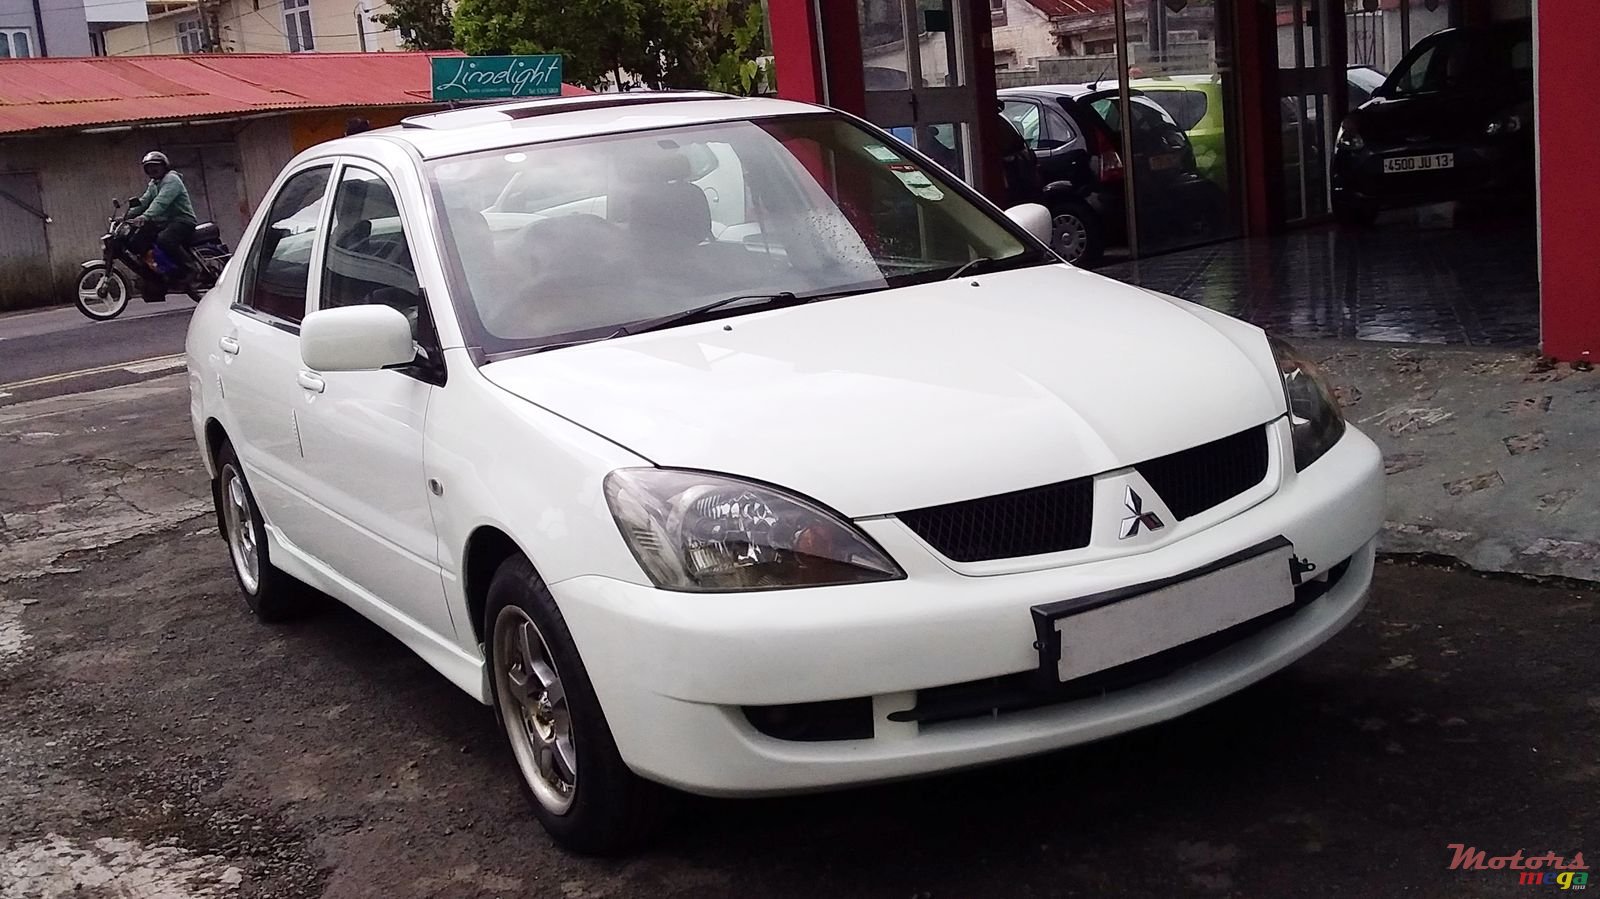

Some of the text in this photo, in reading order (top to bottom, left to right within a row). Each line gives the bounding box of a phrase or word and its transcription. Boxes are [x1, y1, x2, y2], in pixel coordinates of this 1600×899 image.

[437, 58, 558, 95] Limelight
[1388, 155, 1449, 171] 4500 JU 13
